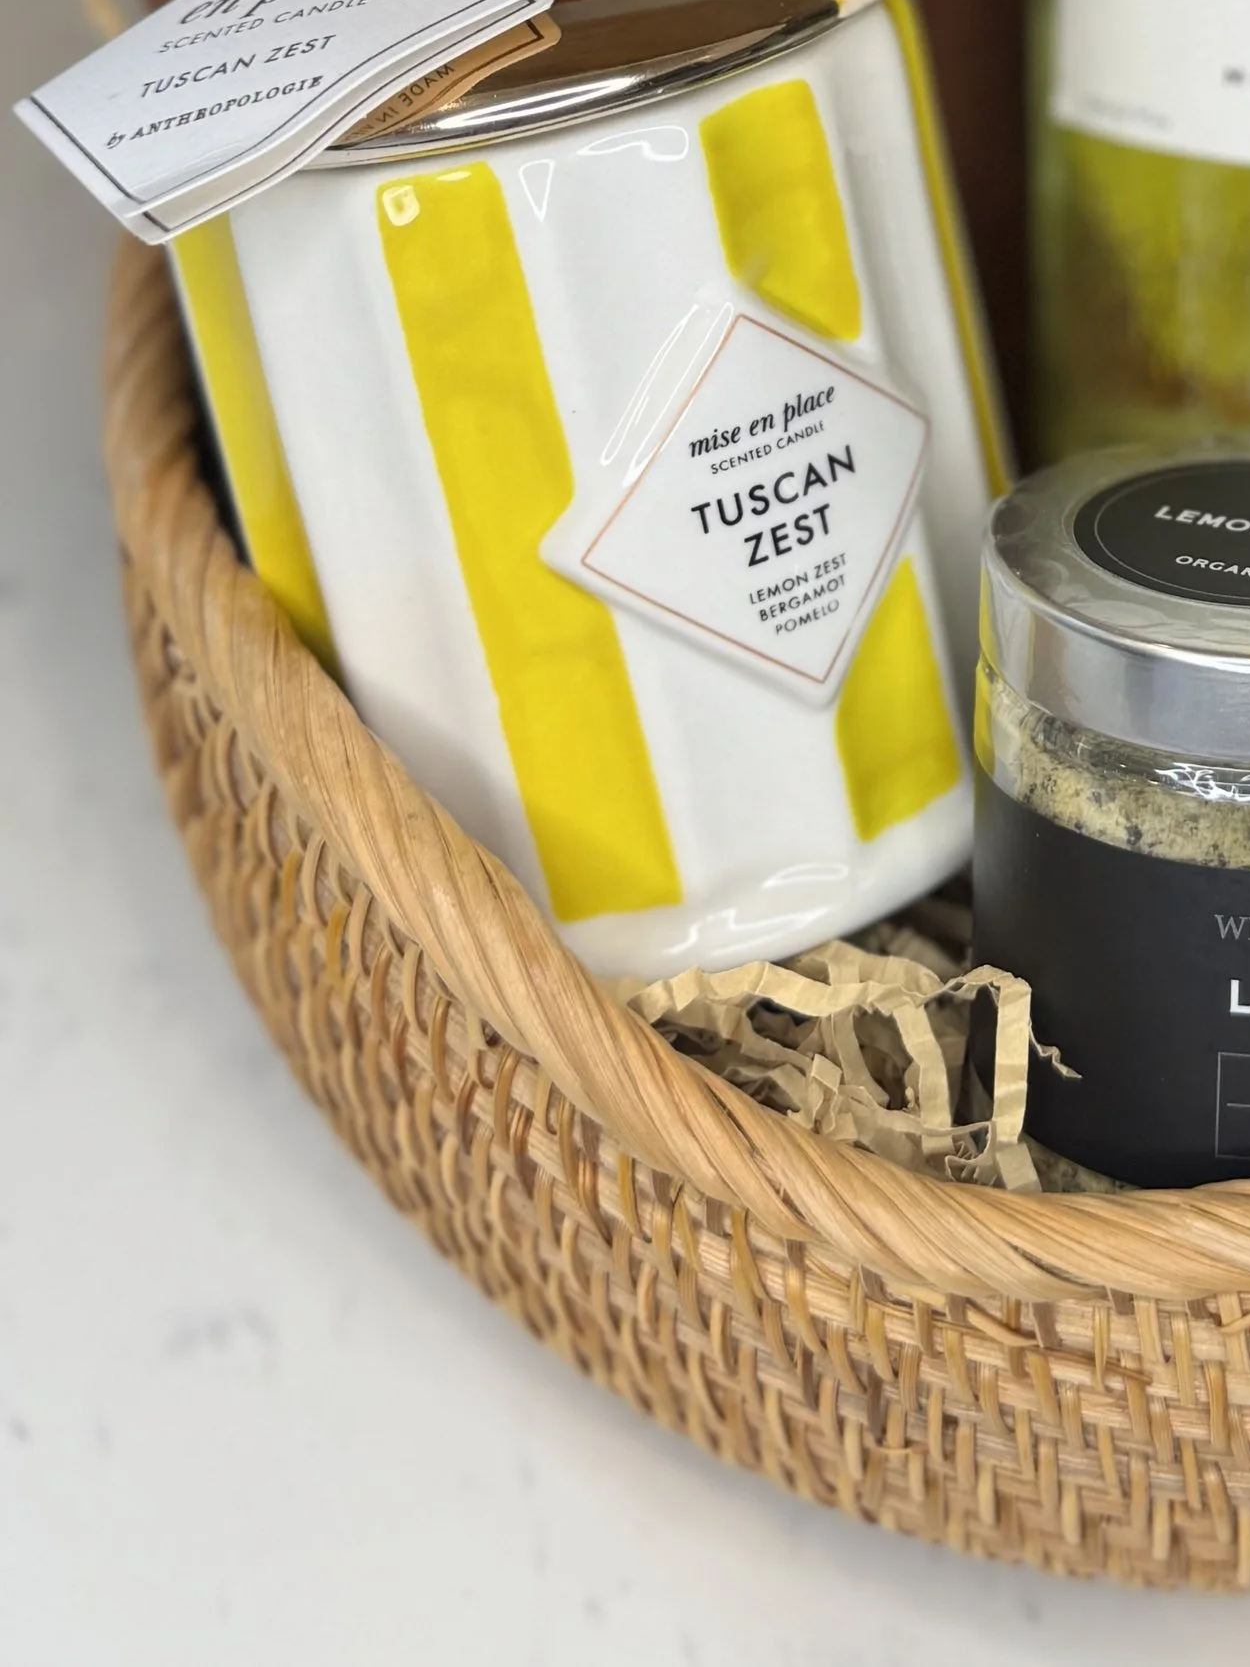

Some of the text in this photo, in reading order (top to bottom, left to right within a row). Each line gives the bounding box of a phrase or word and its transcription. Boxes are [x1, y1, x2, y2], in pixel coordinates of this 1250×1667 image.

[158, 17, 264, 54] SCENTED
[140, 34, 338, 98] TUSCAN ZEST
[105, 131, 126, 150] by
[129, 75, 325, 140] ANTHROPOLOGIE
[689, 386, 835, 458] mise en place
[711, 421, 825, 474] SCENTED CANDLE
[691, 445, 856, 534] TUSCAN
[744, 503, 830, 567] ZEST
[749, 553, 847, 605] LEMON ZEST
[759, 574, 845, 621] BERGAMOT
[775, 599, 840, 634] POMELO
